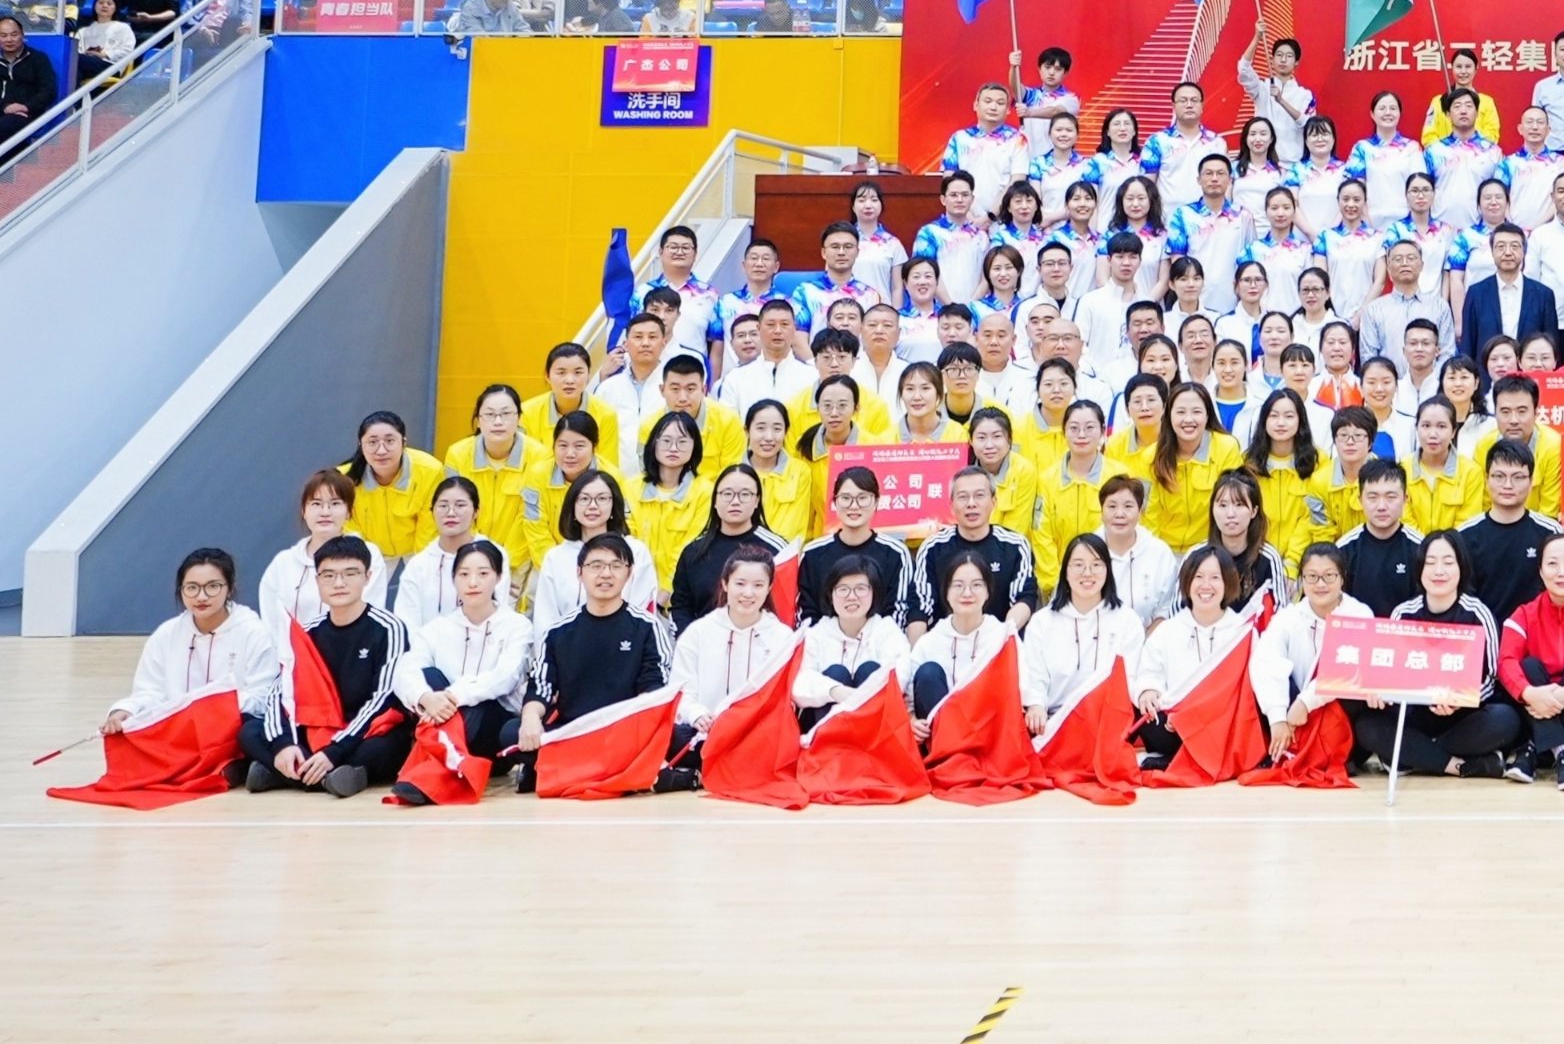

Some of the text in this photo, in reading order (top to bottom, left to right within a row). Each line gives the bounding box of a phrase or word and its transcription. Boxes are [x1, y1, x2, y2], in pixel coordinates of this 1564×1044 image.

[623, 58, 689, 71] 广杰公司
[627, 91, 681, 109] 洗手间
[613, 110, 694, 119] WASHING ROOM
[1336, 645, 1465, 672] 集团总部
